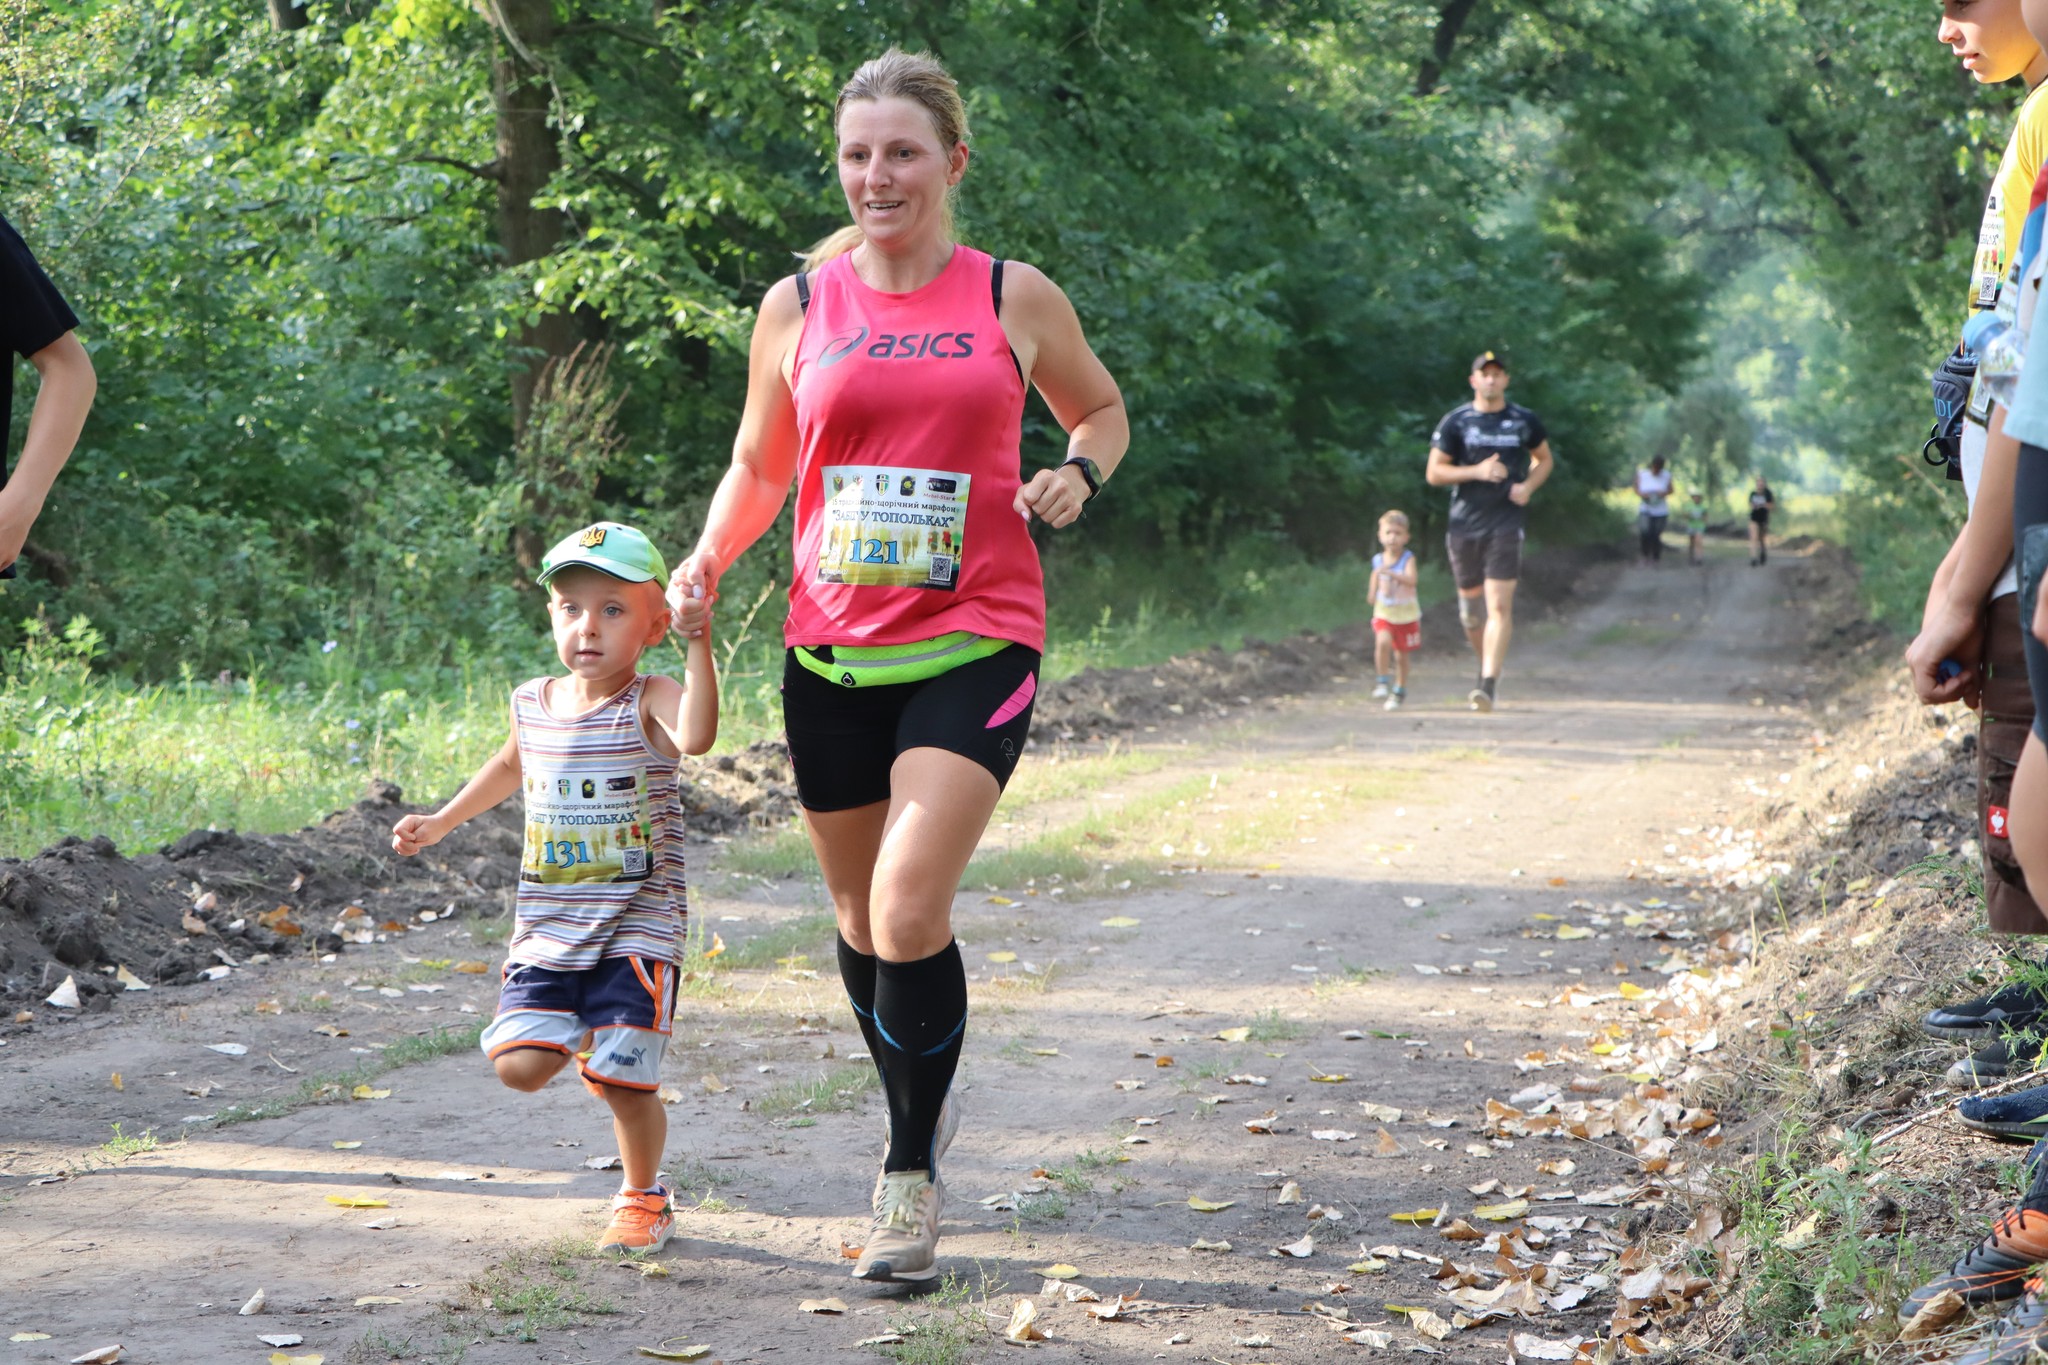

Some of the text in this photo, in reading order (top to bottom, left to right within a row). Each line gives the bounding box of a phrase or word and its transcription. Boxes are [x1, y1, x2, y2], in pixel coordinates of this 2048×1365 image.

[860, 511, 870, 521] У
[849, 538, 900, 565] 121
[544, 841, 591, 869] 131
